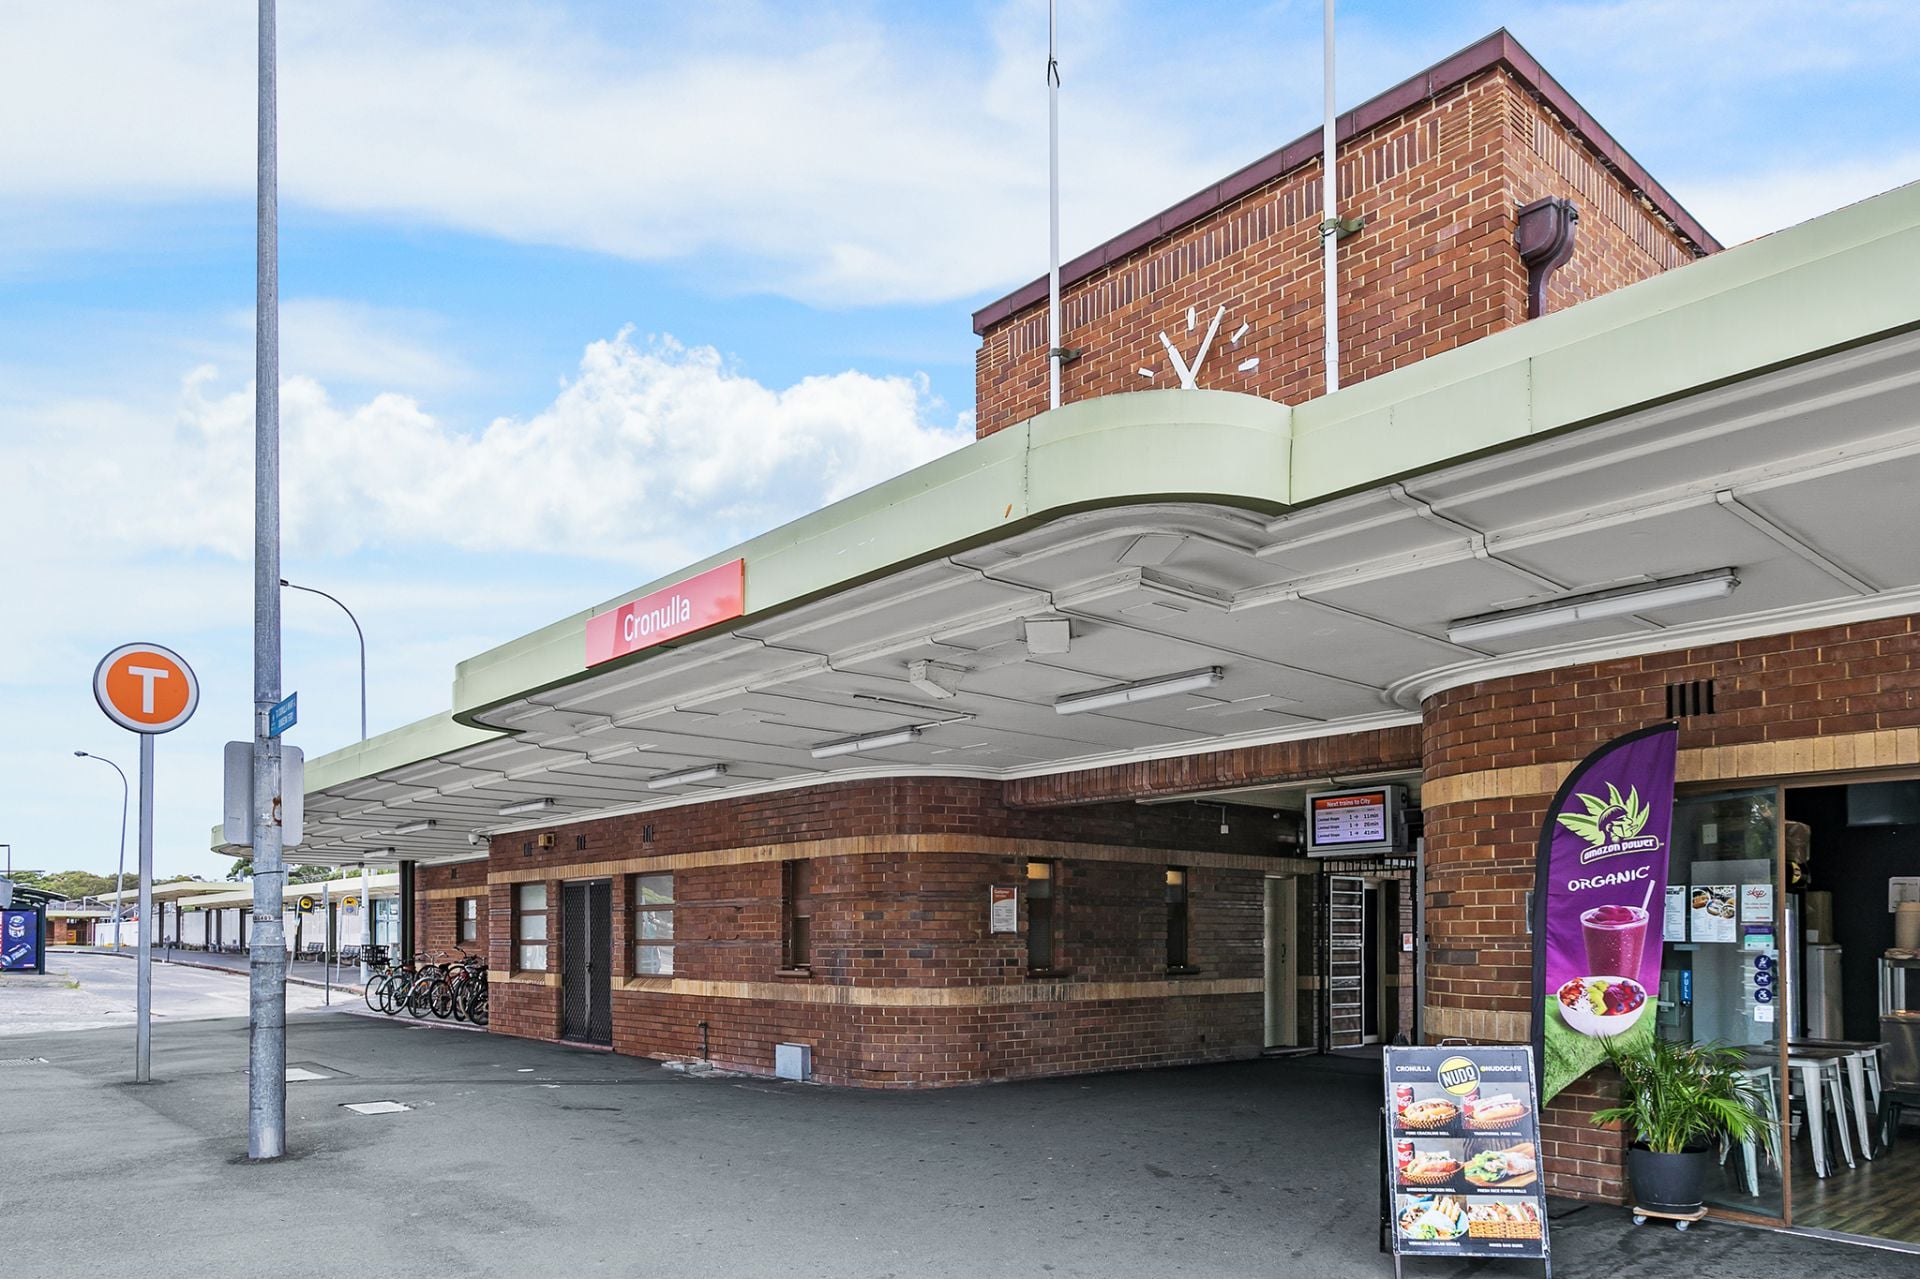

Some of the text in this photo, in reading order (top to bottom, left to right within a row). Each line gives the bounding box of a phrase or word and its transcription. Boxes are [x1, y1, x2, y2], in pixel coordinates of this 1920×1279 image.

[624, 594, 690, 642] Cronulla
[128, 666, 168, 714] T
[1584, 839, 1655, 860] amazon power
[1568, 865, 1650, 892] ORGANIC
[1442, 1066, 1476, 1087] NUDO
